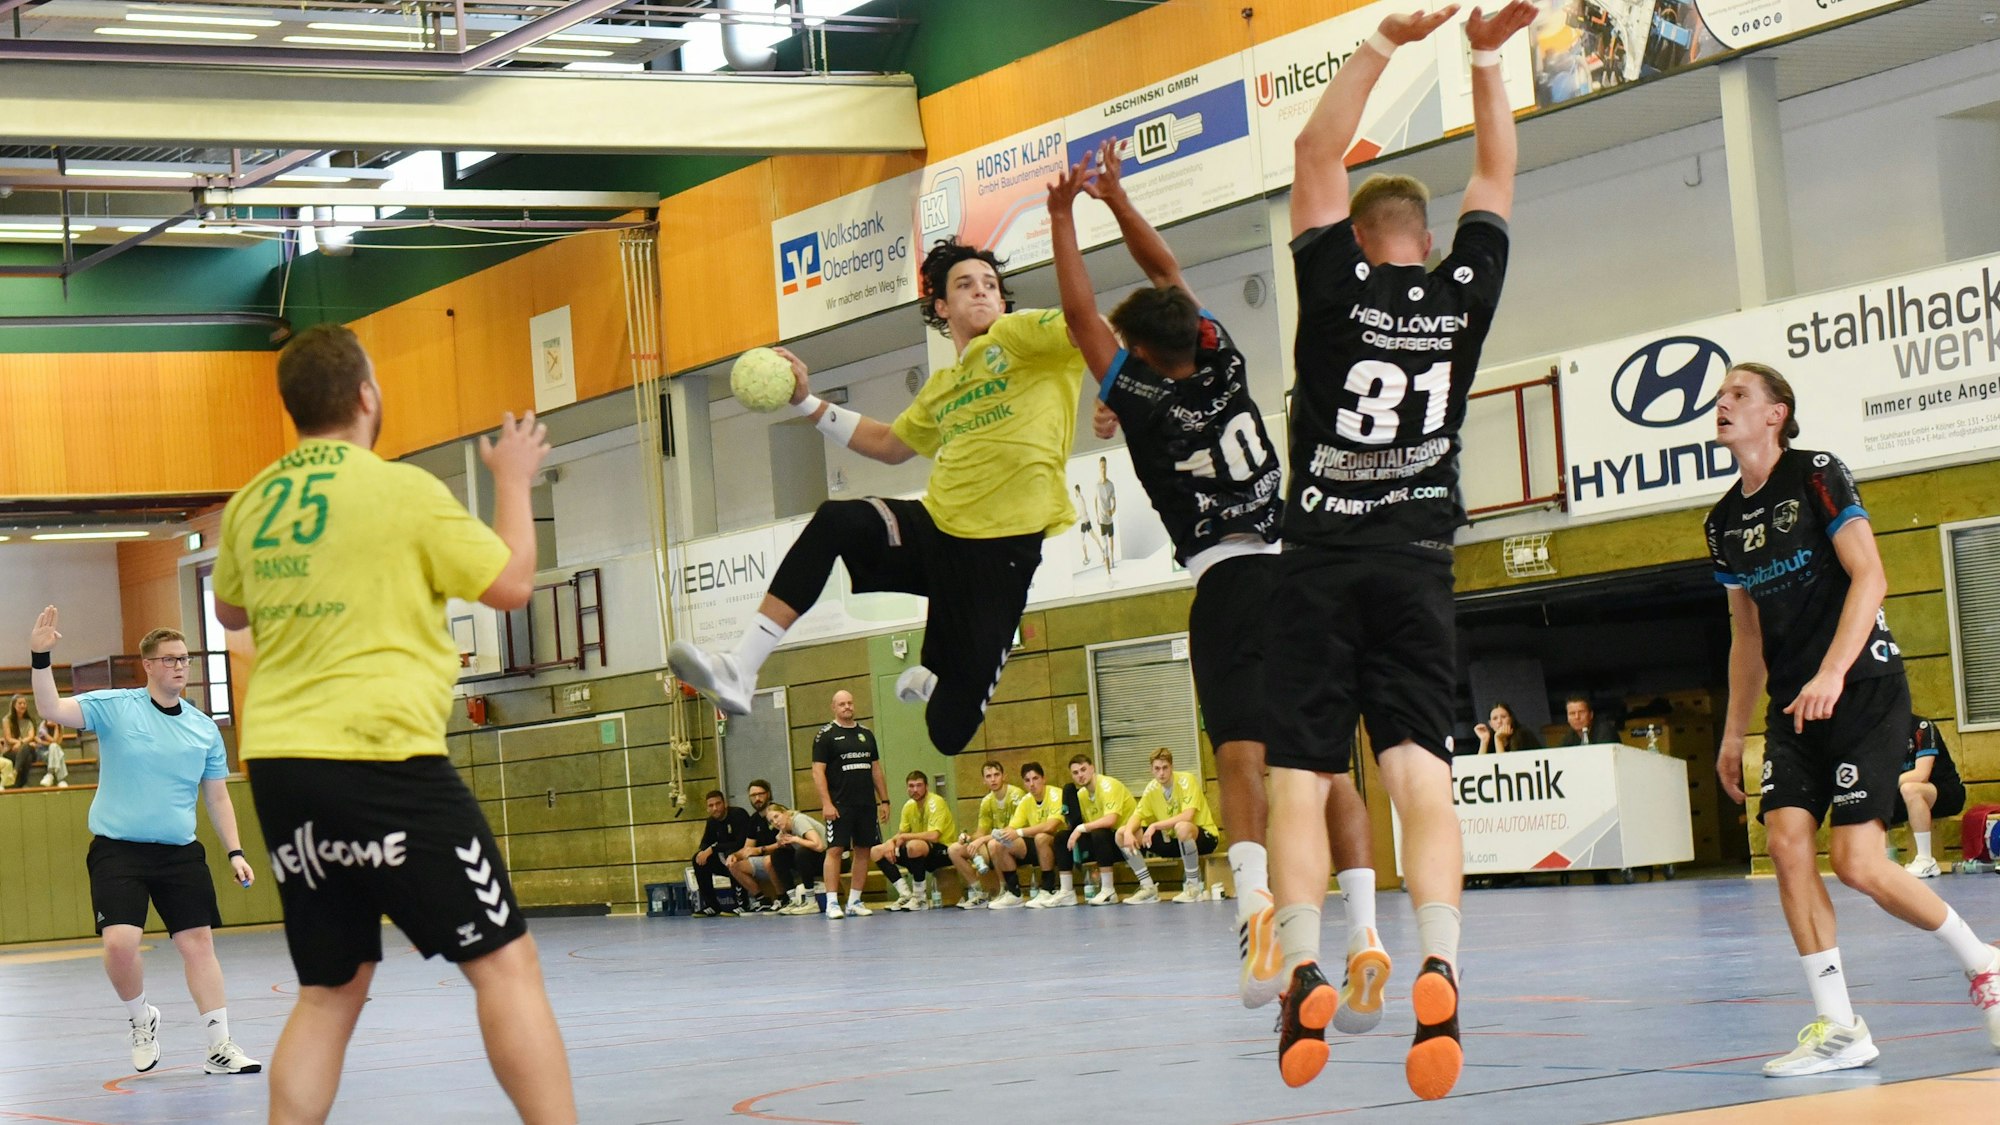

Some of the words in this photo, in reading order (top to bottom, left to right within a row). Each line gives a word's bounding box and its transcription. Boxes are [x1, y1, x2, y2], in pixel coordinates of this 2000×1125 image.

[1103, 86, 1164, 117] LASCHINSKI
[1167, 74, 1199, 94] GMBH
[976, 147, 1018, 181] HORST
[1021, 132, 1062, 166] KLAPP
[978, 180, 1003, 196] GmbH
[1001, 160, 1064, 189] Bauunternehmung
[820, 210, 885, 251] Volksbank
[923, 195, 946, 230] HK
[823, 246, 884, 282] Oberberg
[887, 236, 907, 261] eG
[825, 296, 837, 310] Wir
[838, 287, 864, 305] machen
[865, 282, 878, 297] den
[879, 278, 895, 294] Weg
[896, 274, 909, 288] frei
[1349, 303, 1394, 332] HBD
[1397, 311, 1469, 333] LÖWEN
[1361, 330, 1453, 351] OBERBERG
[1335, 359, 1452, 445] 31
[1864, 397, 1912, 417] Immer
[1918, 389, 1952, 411] gute
[1957, 376, 2000, 400] Ange
[1911, 424, 1930, 436] GmbH
[1571, 438, 1741, 502] HYUND
[252, 472, 337, 549] 25
[1742, 523, 1766, 553] 23
[661, 551, 767, 597] VIEBAHN
[1496, 813, 1570, 834] AUTOMATED.
